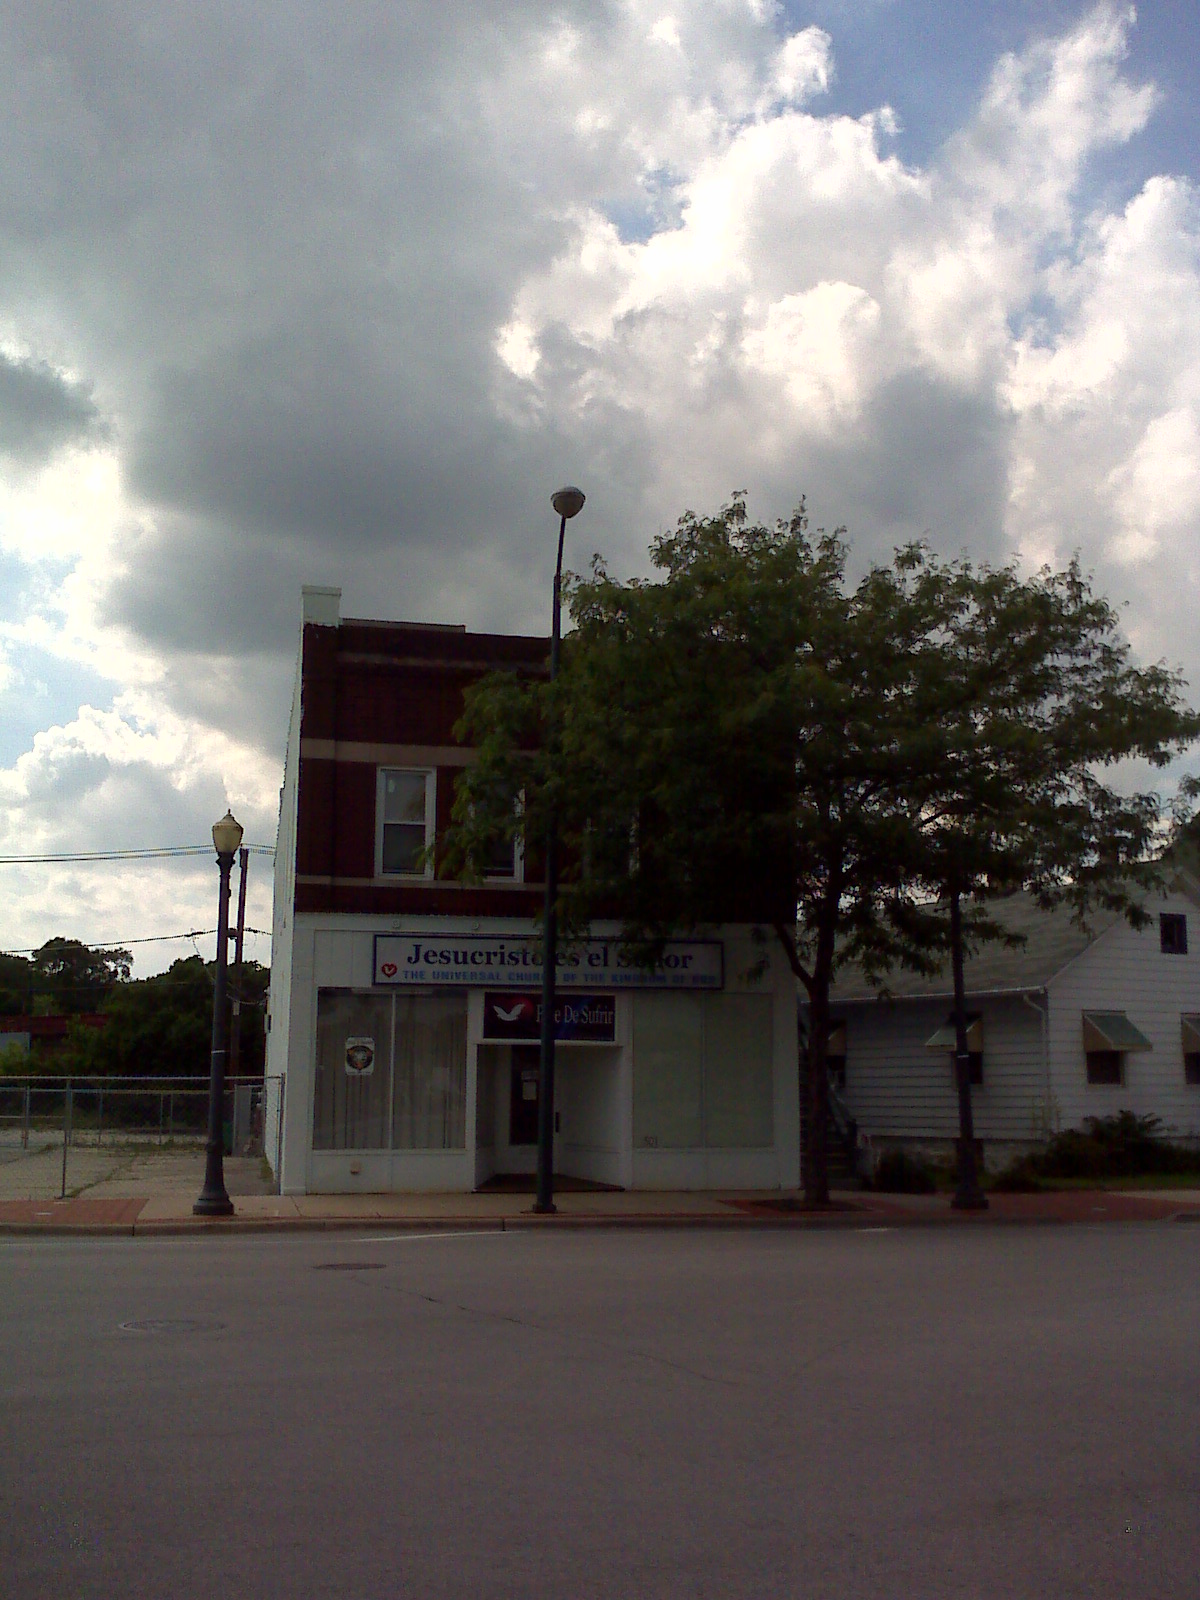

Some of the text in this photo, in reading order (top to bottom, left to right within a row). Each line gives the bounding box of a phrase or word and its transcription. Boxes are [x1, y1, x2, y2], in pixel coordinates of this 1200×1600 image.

[555, 951, 580, 967] es
[587, 946, 609, 967] el
[403, 970, 426, 980] THE
[432, 970, 502, 981] UNIVERSAL
[563, 973, 577, 982] OF
[583, 973, 605, 983] THE
[564, 1004, 578, 1024] De
[581, 1004, 614, 1024] Sufrir
